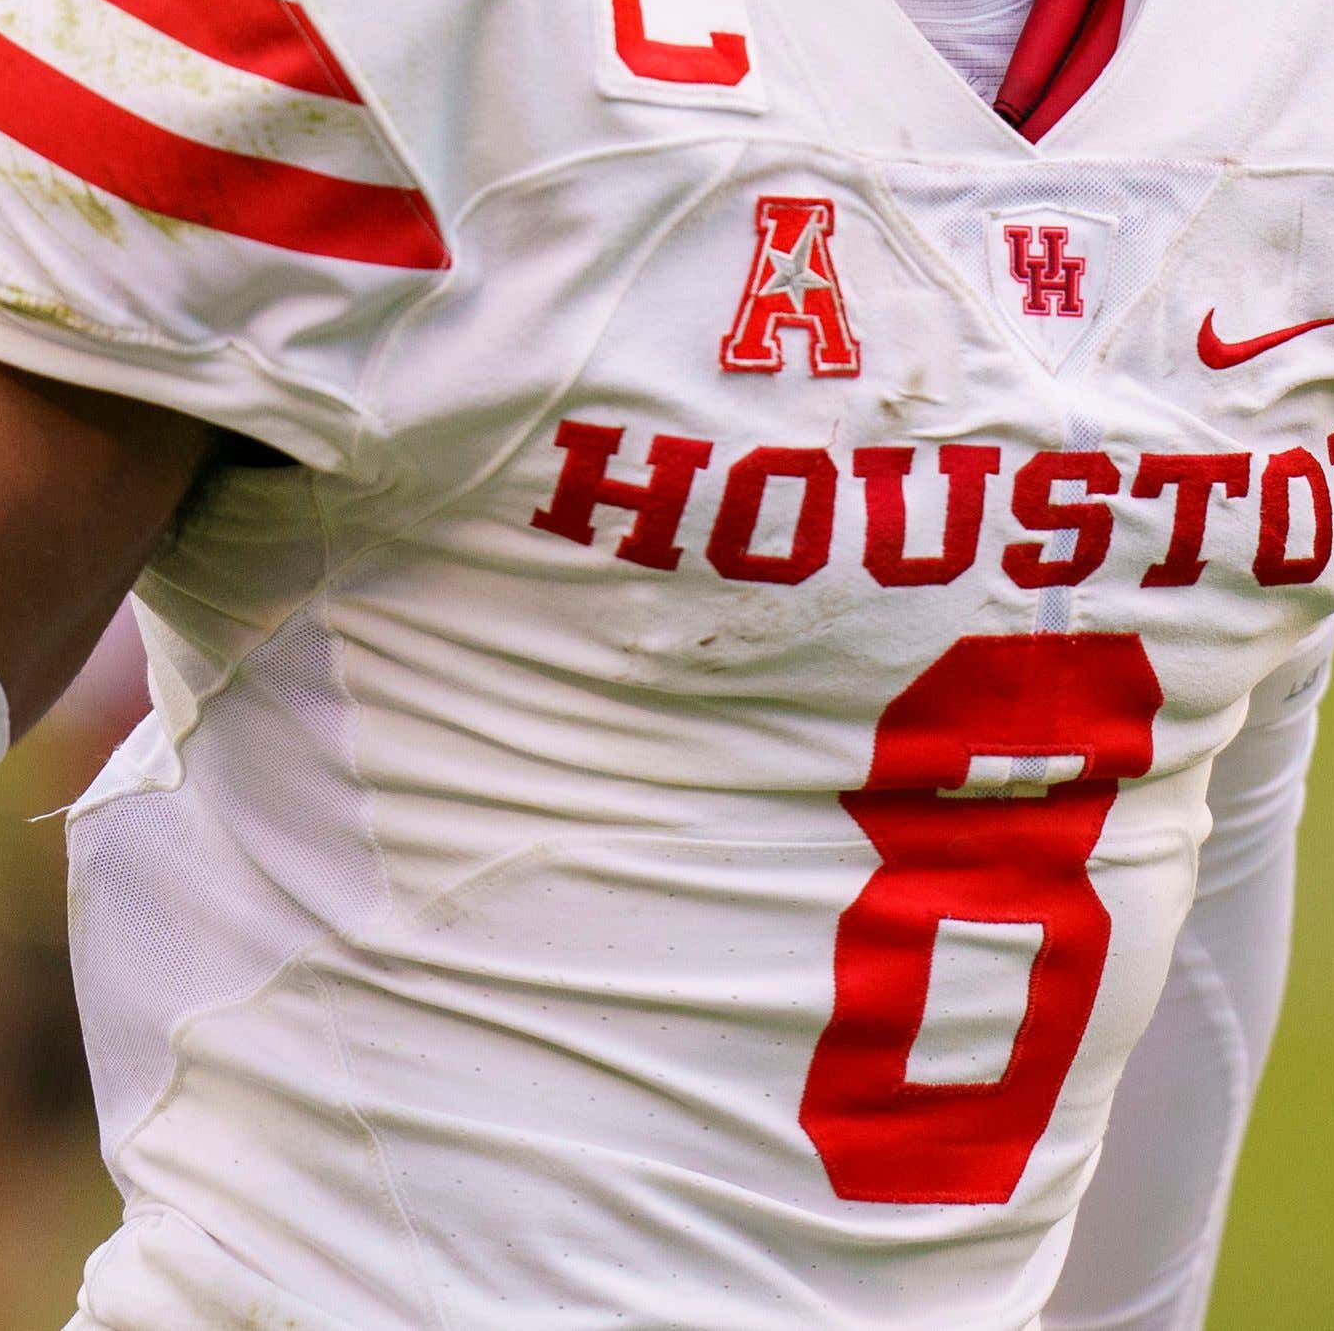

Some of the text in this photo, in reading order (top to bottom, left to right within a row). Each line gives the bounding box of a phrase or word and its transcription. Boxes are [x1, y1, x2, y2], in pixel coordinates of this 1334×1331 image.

[719, 194, 861, 378] A
[1004, 224, 1086, 317] UH
[798, 631, 1165, 1205] 8
